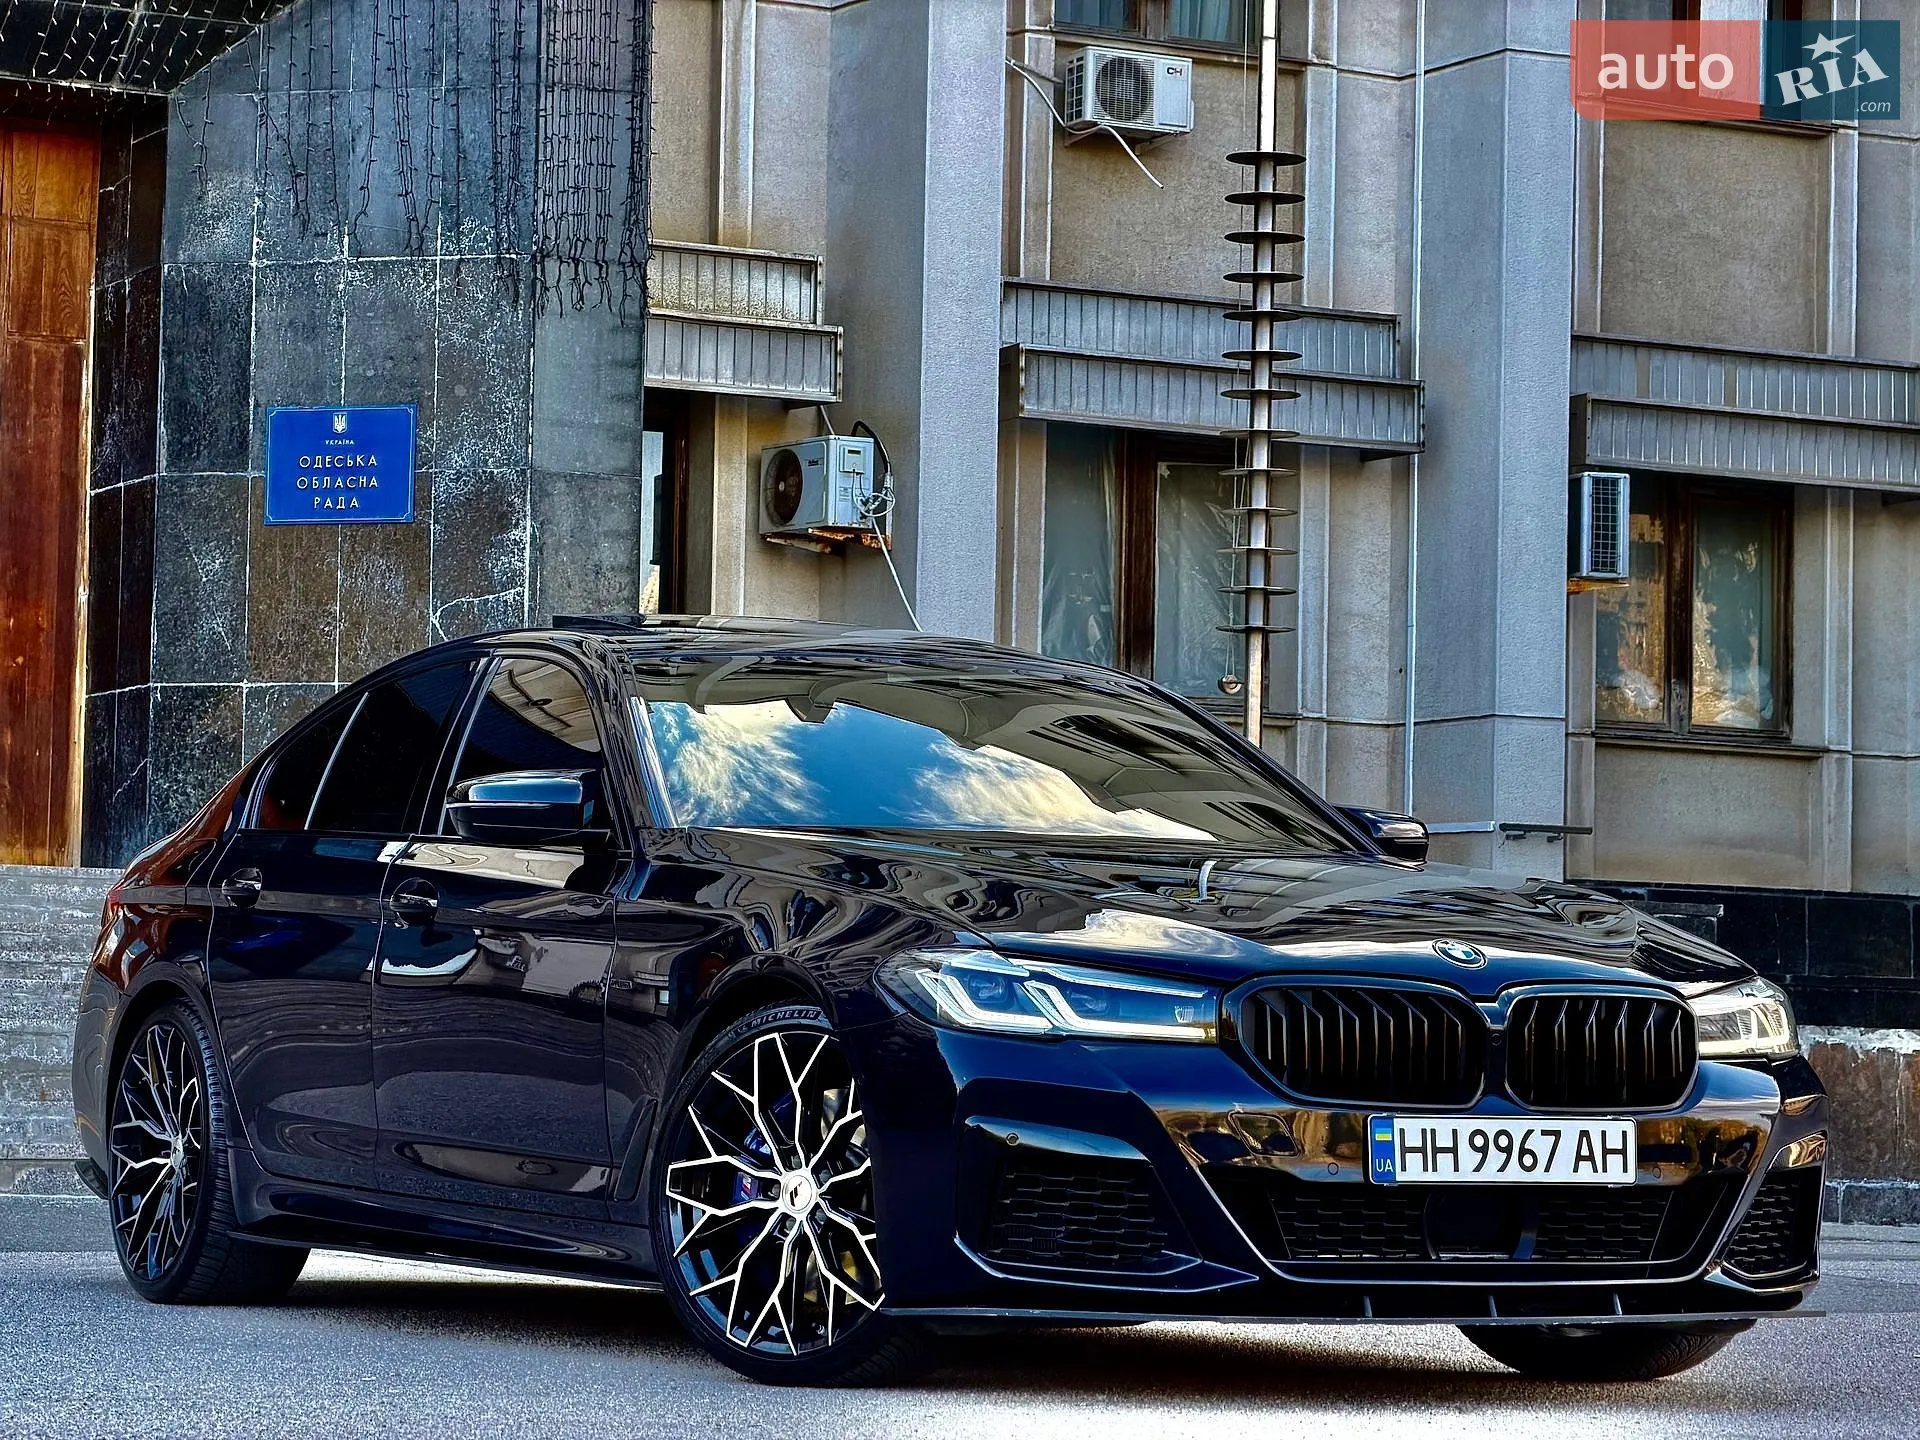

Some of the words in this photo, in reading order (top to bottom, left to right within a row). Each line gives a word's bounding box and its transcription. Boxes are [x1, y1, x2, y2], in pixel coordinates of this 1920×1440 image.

[299, 455, 377, 468] ОДЕСЬКА
[296, 476, 378, 489] ОБЛАСНА
[314, 497, 359, 509] РАДА
[750, 1009, 817, 1028] MICHELIN
[1398, 1127, 1460, 1173] HH
[1468, 1128, 1562, 1173] 9967
[1572, 1129, 1629, 1174] AH
[1375, 1158, 1393, 1173] UA
